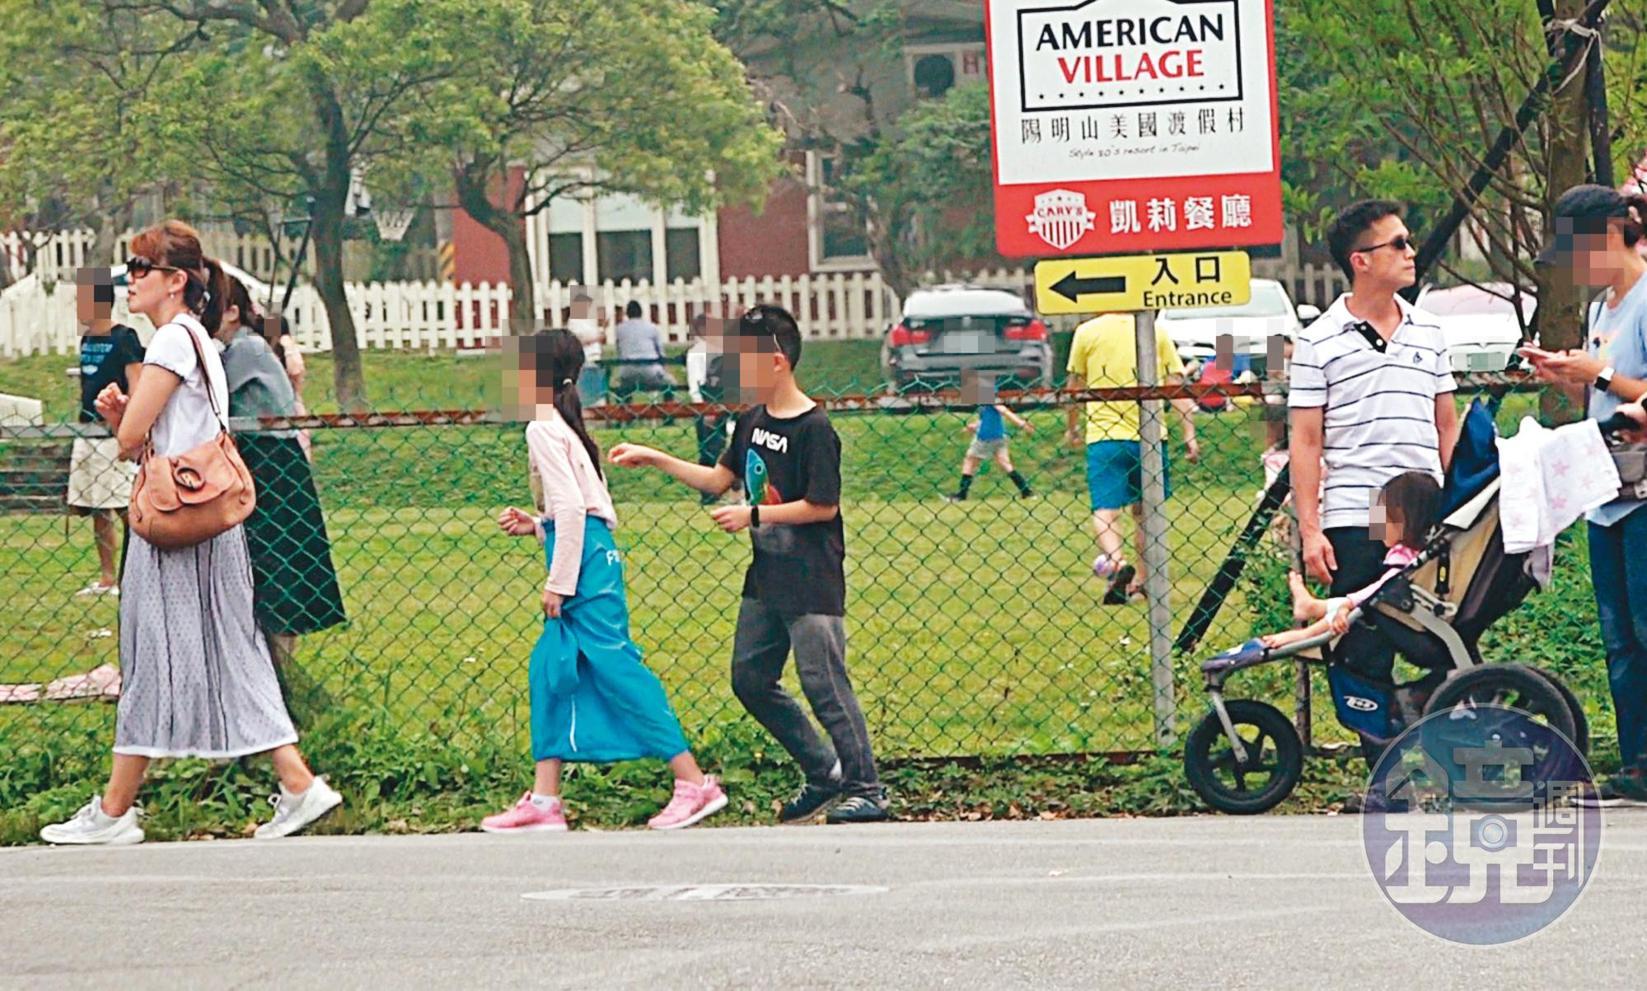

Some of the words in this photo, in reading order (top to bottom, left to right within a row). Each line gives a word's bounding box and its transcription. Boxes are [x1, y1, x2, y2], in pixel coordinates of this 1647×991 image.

[1036, 14, 1224, 51] AMERICAN
[1057, 50, 1205, 84] VILLAGE
[1021, 107, 1244, 144] 陽明山美國渡假村
[1109, 194, 1253, 234] 凱莉餐廳
[1151, 256, 1221, 286] 入口
[1144, 290, 1232, 308] Entrance
[751, 427, 788, 454] NASA
